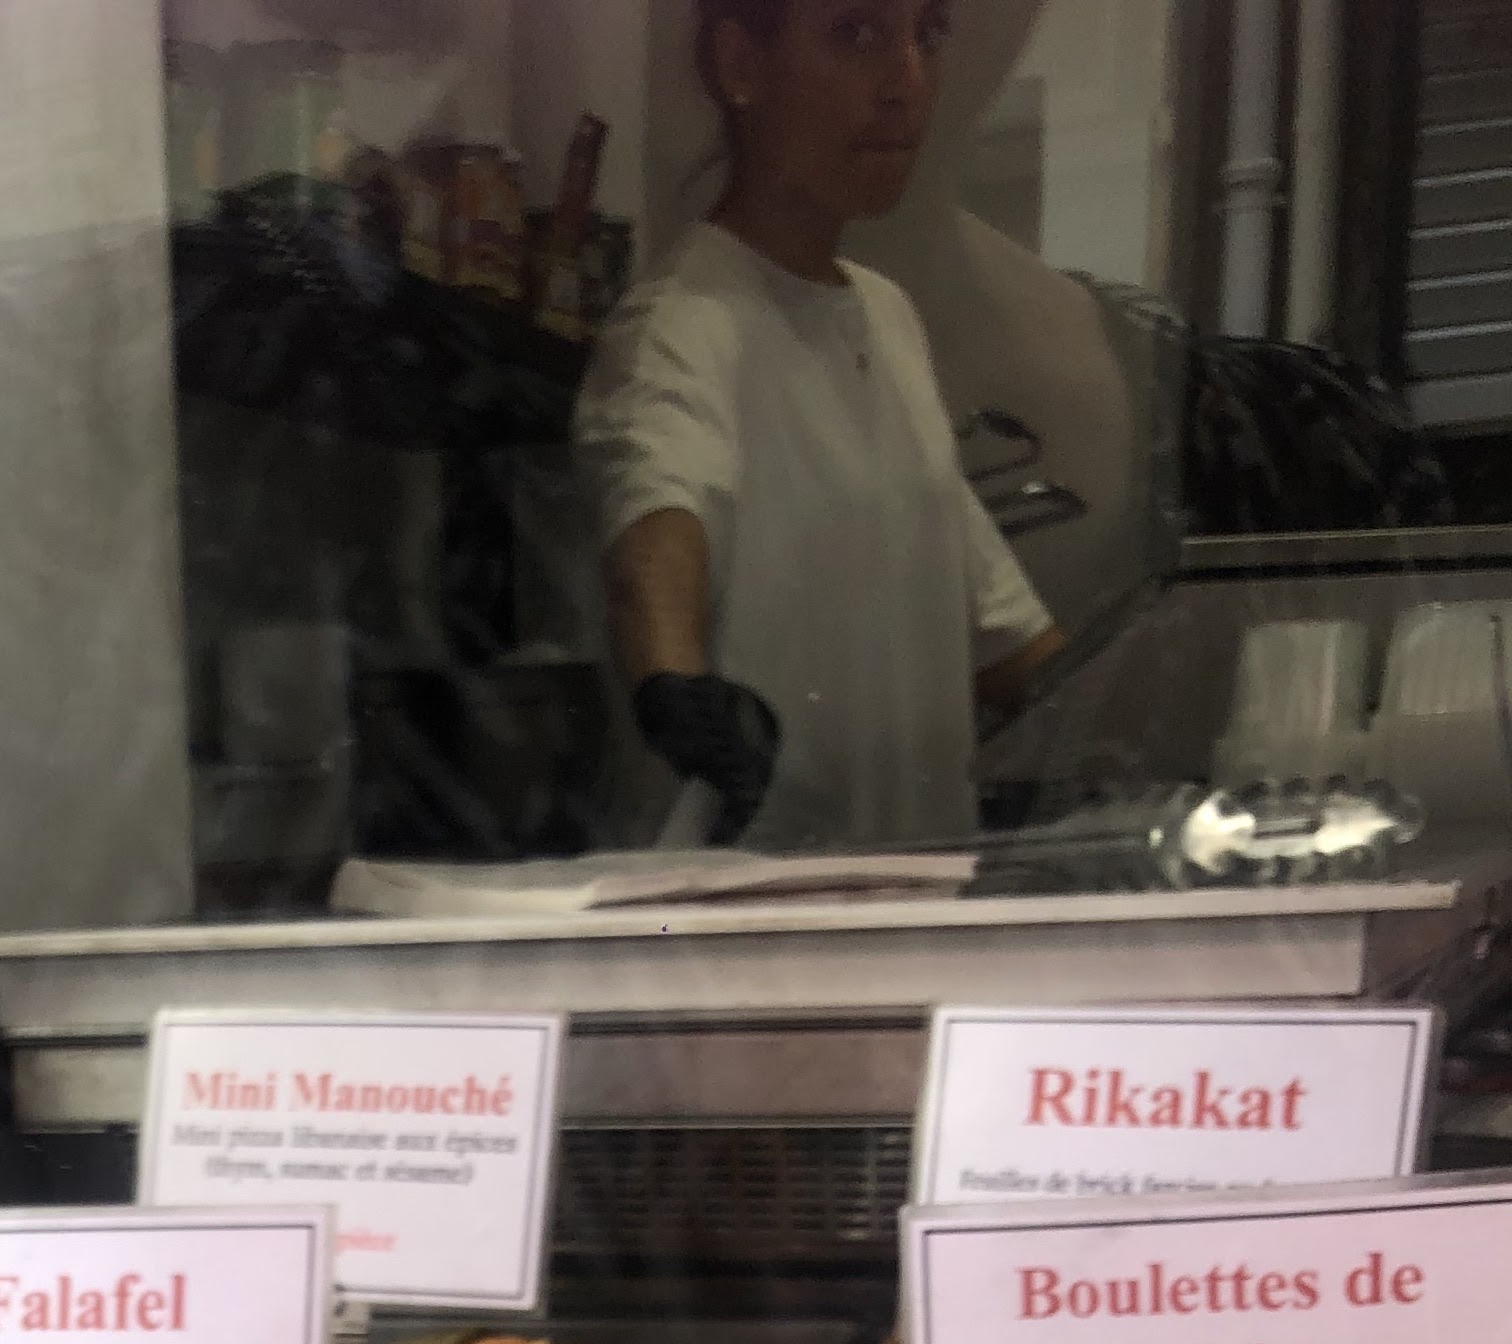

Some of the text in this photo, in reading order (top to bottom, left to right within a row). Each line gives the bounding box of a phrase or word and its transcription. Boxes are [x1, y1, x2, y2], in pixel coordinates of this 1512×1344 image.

[185, 1071, 513, 1116] Mini Manouché
[1025, 1067, 1306, 1130] Rikakat
[1016, 1252, 1425, 1320] Boulettes de
